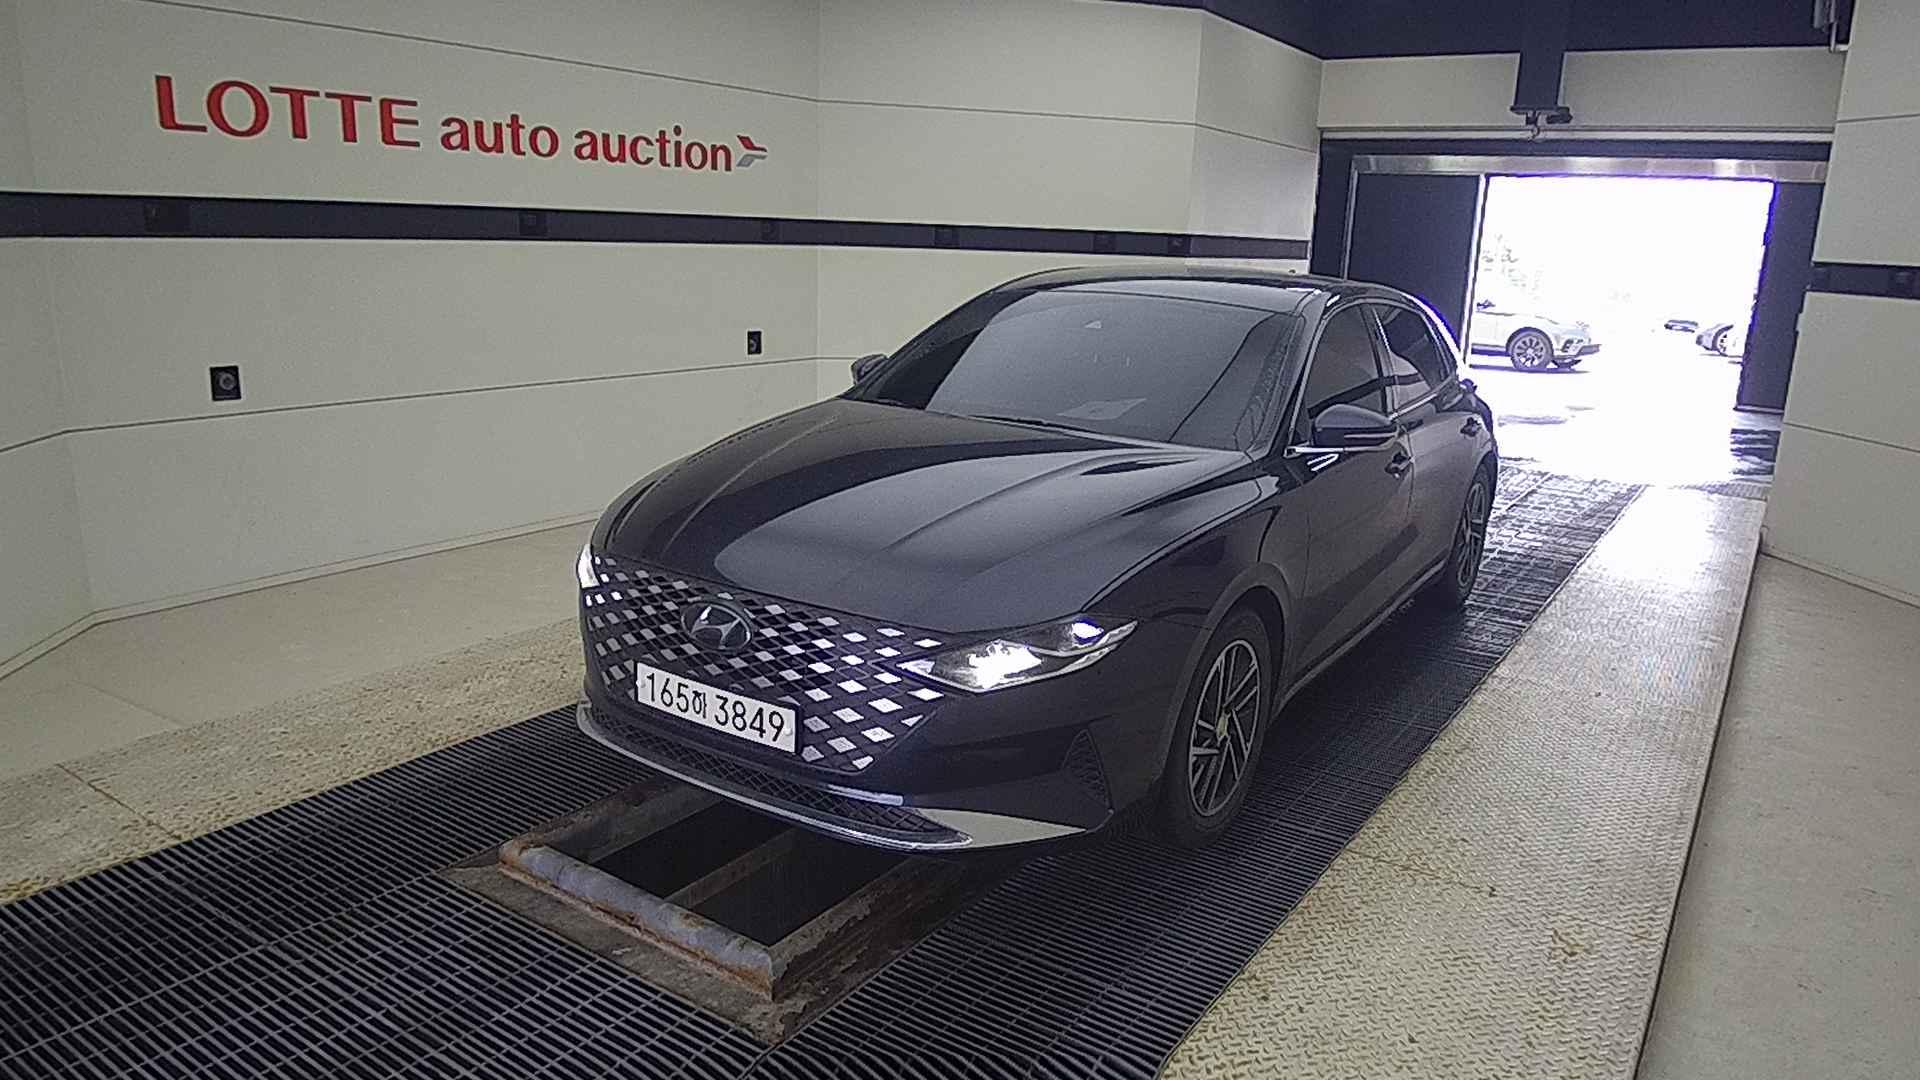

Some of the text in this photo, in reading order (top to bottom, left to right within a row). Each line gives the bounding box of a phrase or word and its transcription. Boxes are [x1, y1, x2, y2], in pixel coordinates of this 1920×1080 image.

[155, 75, 733, 172] LOTTE auto auction
[646, 673, 785, 742] 165하 3849
